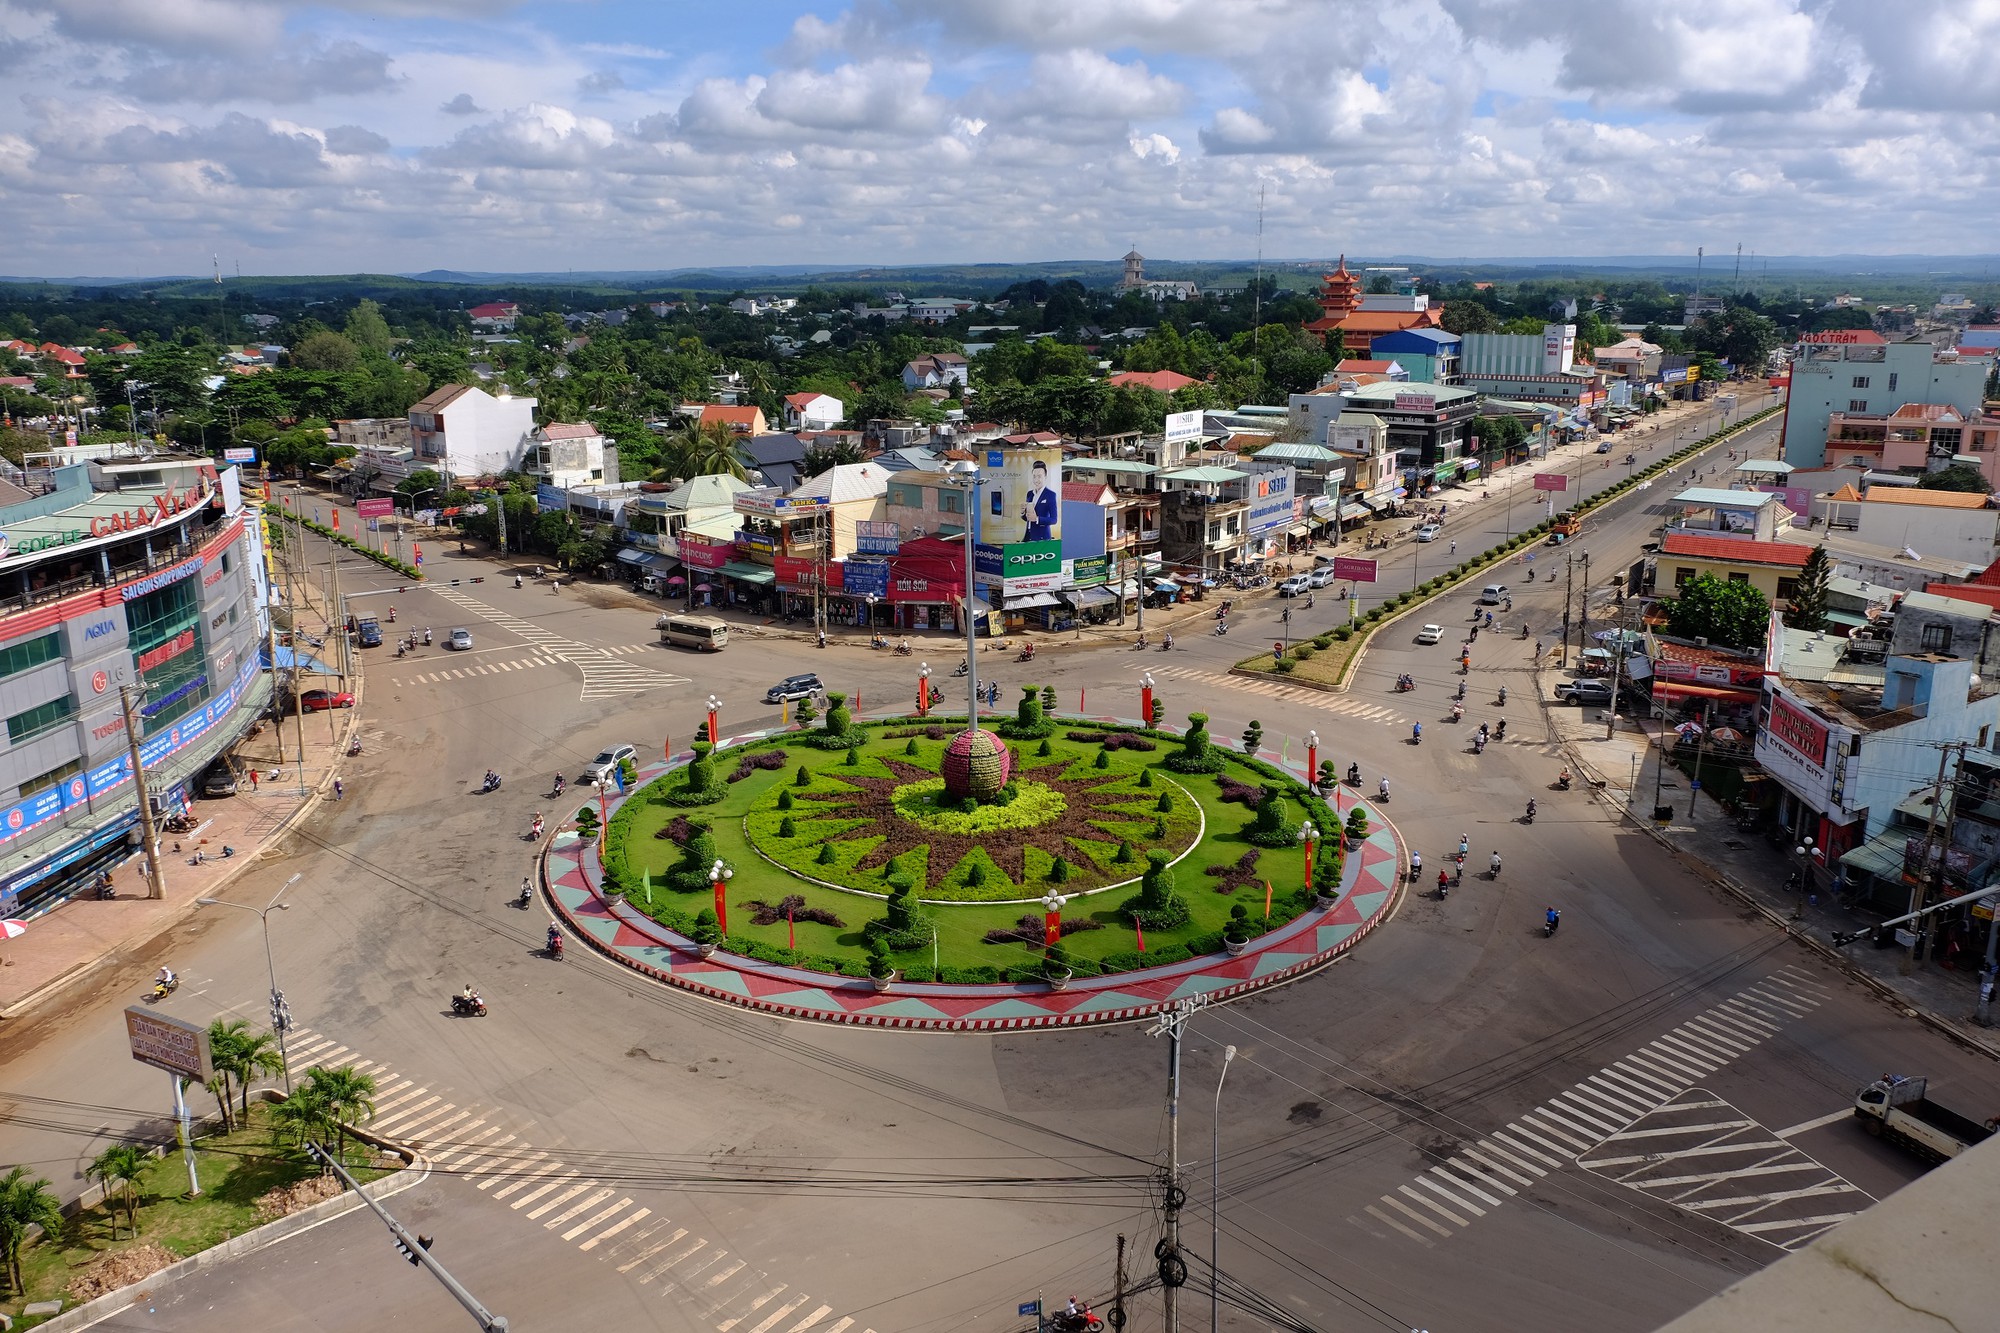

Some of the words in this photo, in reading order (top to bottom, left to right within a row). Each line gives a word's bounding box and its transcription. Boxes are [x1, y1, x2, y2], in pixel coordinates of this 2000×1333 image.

[1797, 333, 1826, 345] NGỌC
[1268, 476, 1287, 494] SHB
[90, 477, 180, 539] GALAXY
[858, 521, 871, 536] K+
[884, 523, 898, 536] K+
[975, 549, 1004, 561] coolpad
[121, 579, 154, 601] SAIGON
[153, 565, 186, 589] SHOPPING
[84, 619, 116, 642] AQUA
[108, 666, 124, 685] LG
[1769, 737, 1805, 767] EYEWEAR
[1805, 763, 1824, 780] CITY
